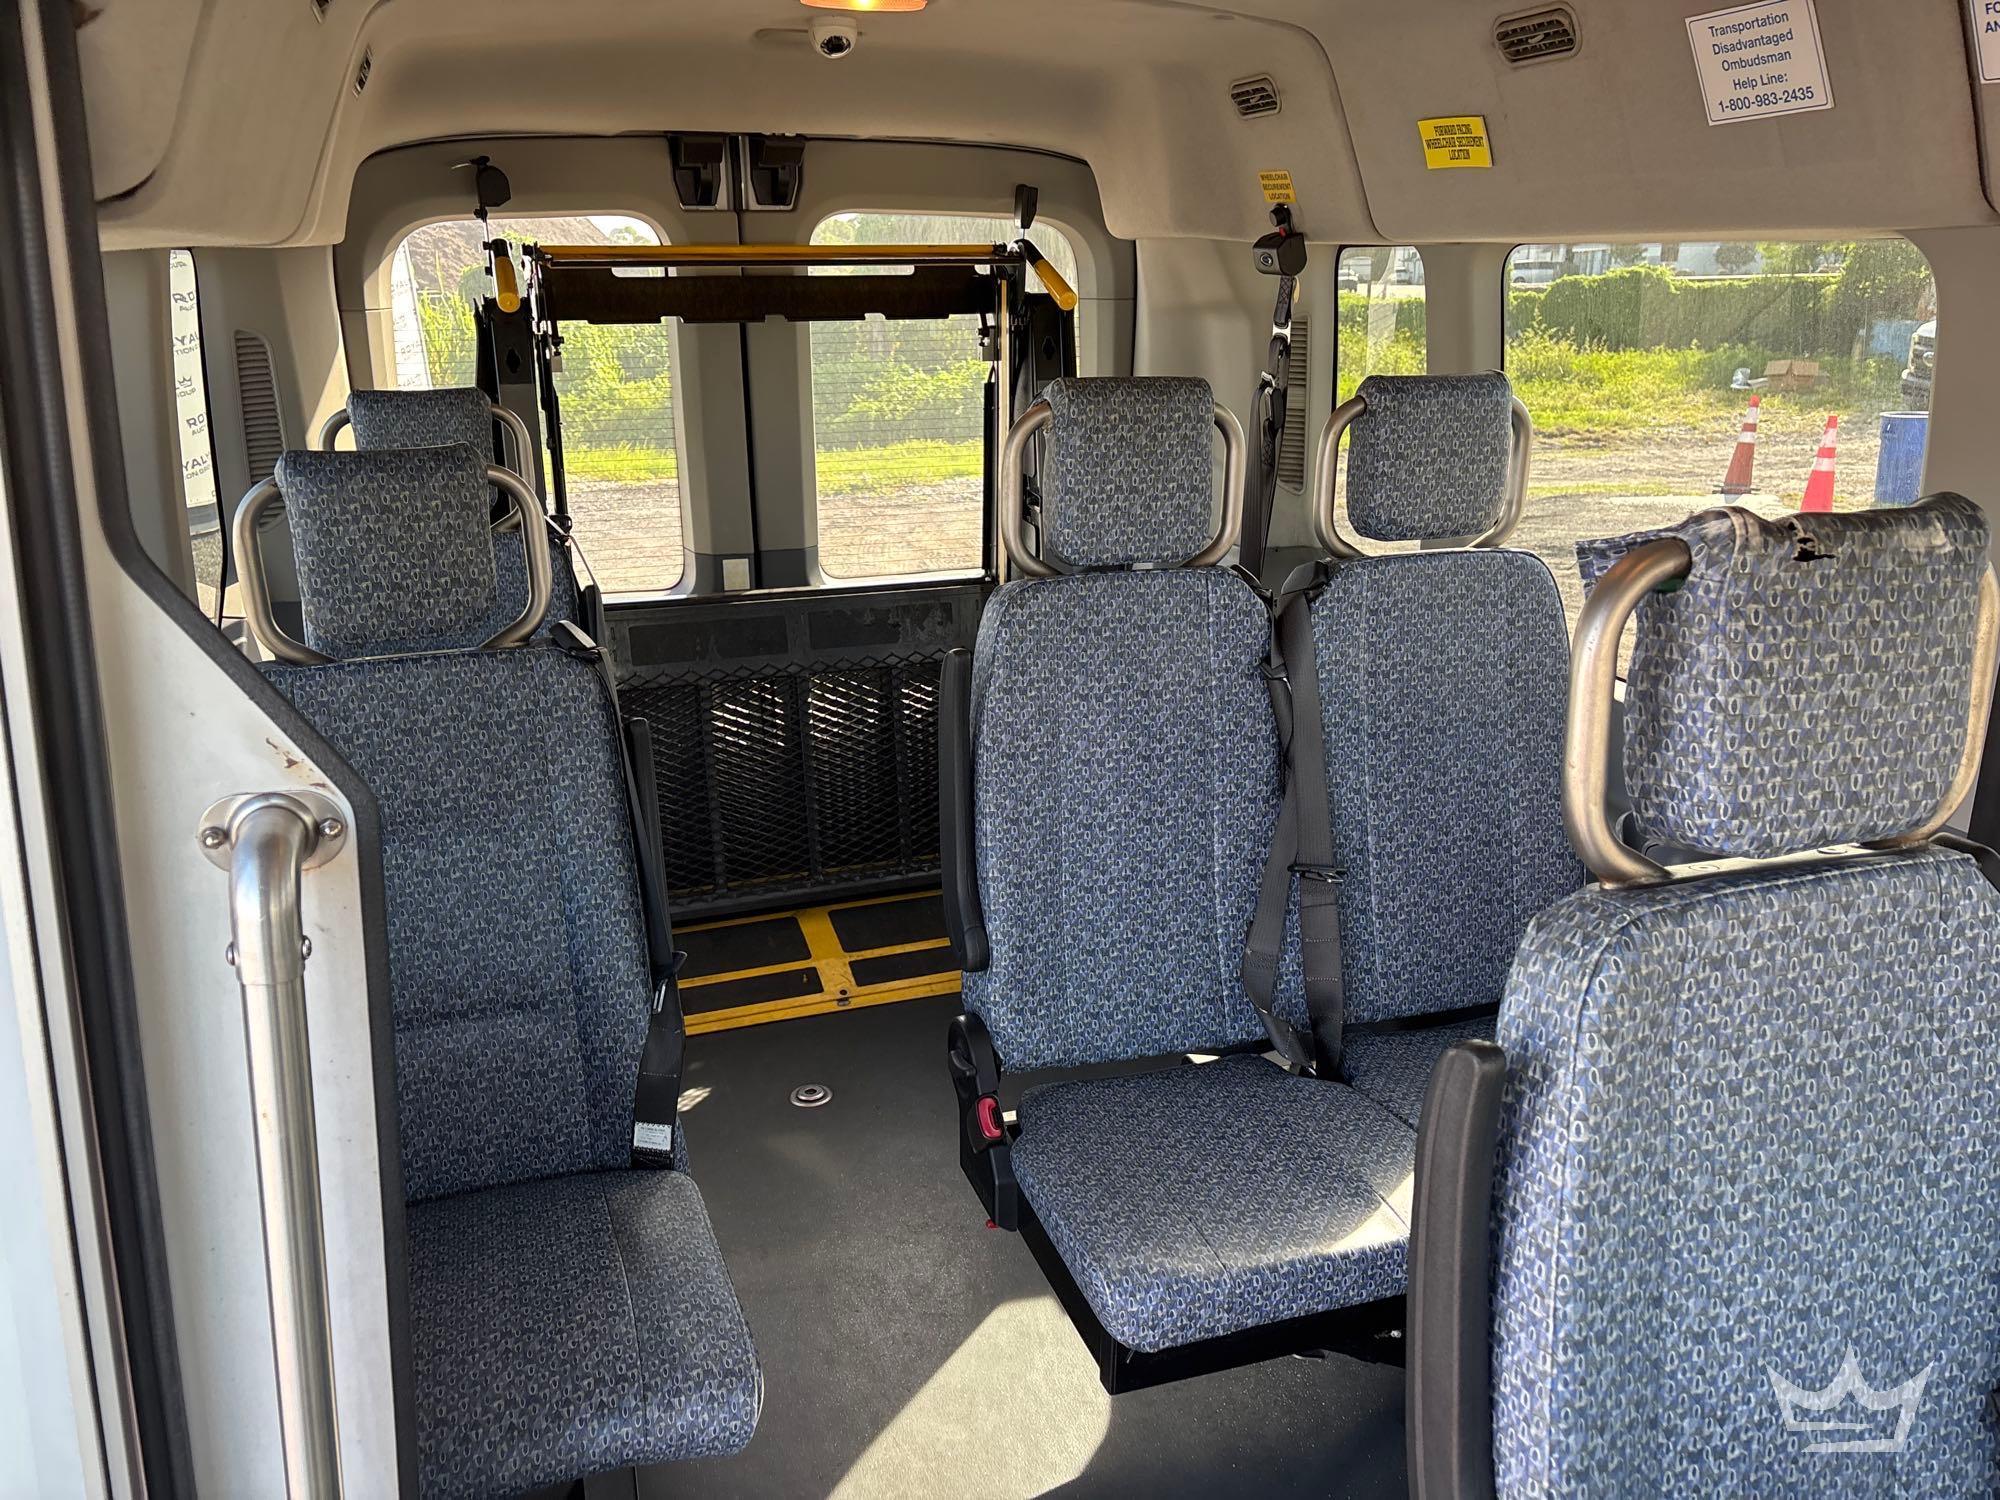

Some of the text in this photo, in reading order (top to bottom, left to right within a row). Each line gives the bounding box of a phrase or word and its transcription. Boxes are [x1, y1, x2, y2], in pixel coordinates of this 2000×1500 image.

[1708, 12, 1789, 38] Transportation
[1712, 28, 1794, 55] Disadvantaged
[1721, 50, 1792, 72] Ombudsman
[1732, 73, 1788, 91] Help Line:
[1718, 86, 1814, 113] 1-800-983-2435
[186, 413, 205, 428] RO
